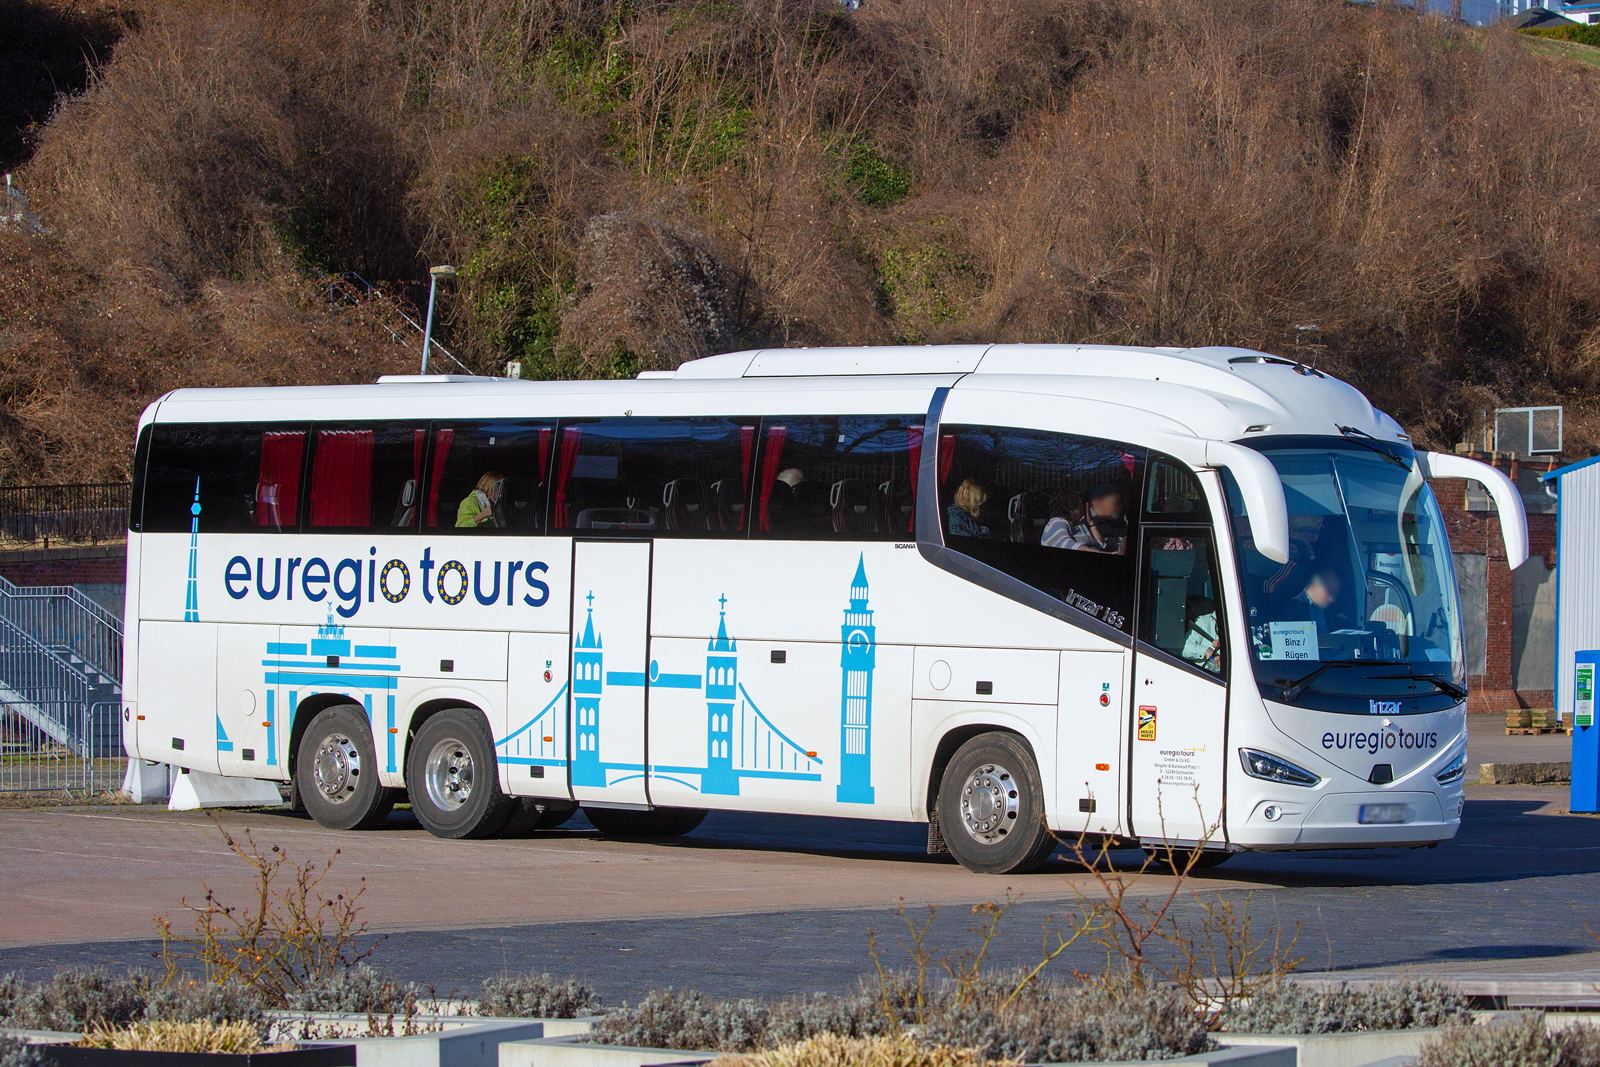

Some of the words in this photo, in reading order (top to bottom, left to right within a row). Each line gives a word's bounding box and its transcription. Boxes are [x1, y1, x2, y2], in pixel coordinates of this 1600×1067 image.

[1065, 588, 1104, 617] Irizar
[1102, 606, 1125, 628] i6s
[1285, 638, 1301, 646] Binz
[1302, 638, 1306, 646] /
[1285, 651, 1308, 661] Rügen
[1370, 700, 1402, 714] Irizar
